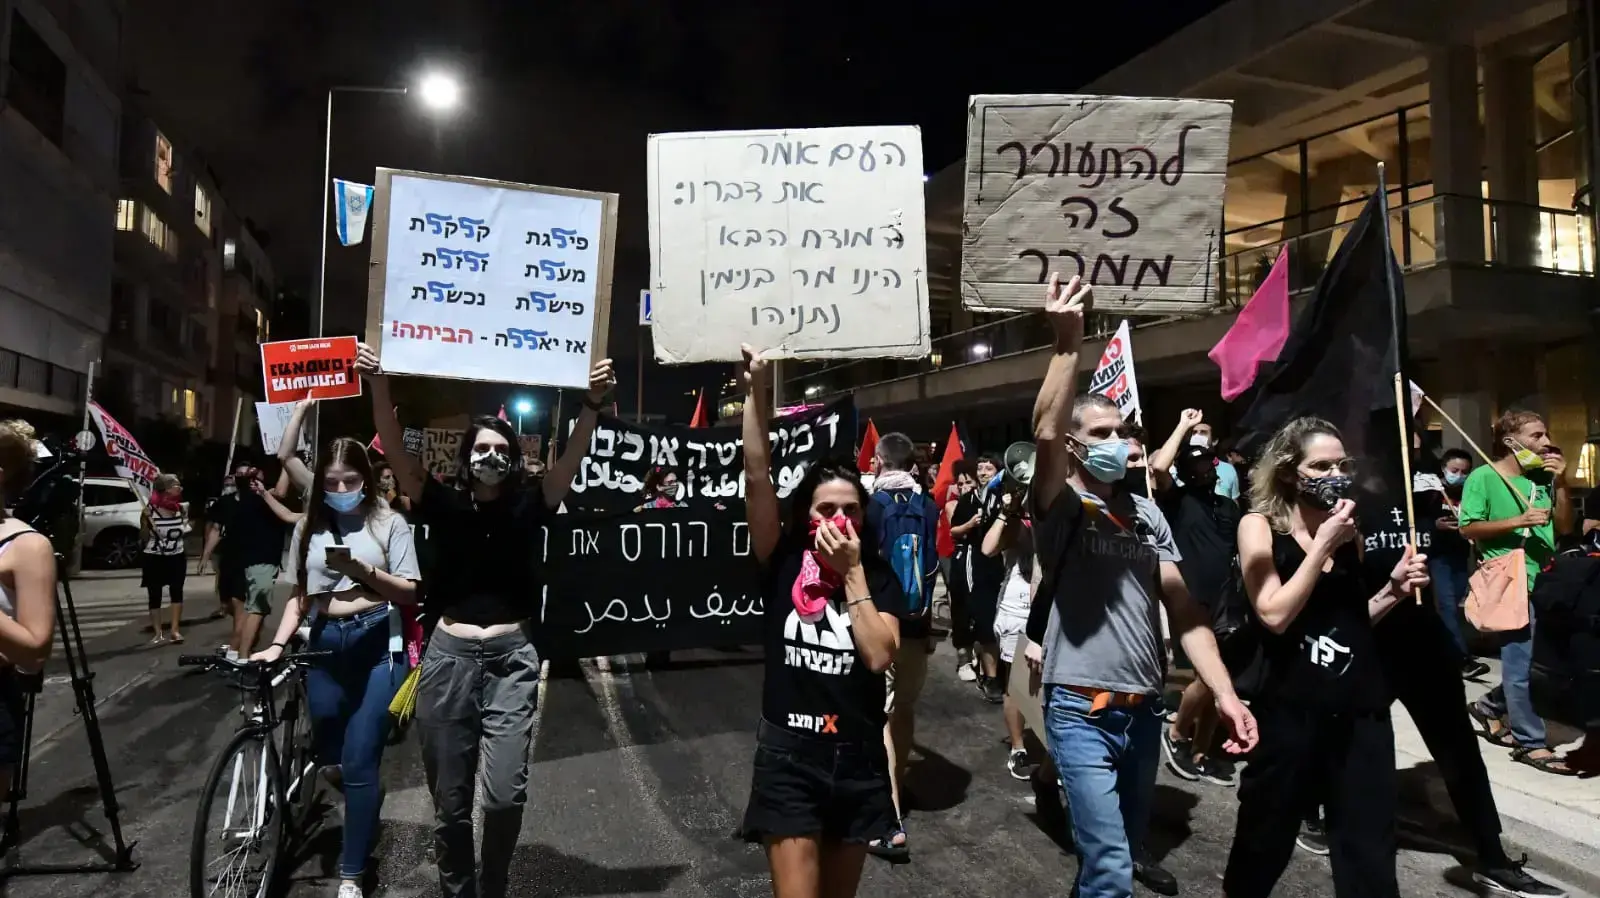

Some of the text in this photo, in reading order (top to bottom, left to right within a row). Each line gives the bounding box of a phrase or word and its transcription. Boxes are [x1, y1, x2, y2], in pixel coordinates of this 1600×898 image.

[747, 140, 906, 172] העם אמר
[997, 125, 1201, 189] להתעורר
[674, 181, 825, 206] את דברו:
[409, 213, 491, 242] קלקלת
[1061, 195, 1139, 238] זה
[525, 228, 589, 250] פילגת
[719, 226, 788, 247] הבא
[421, 247, 490, 272] זלזלת
[524, 259, 586, 283] מעלת
[411, 281, 486, 306] נכשלת
[700, 266, 901, 306] הינו מר בנימין
[515, 291, 585, 315] פישלת
[391, 320, 473, 344] הביתה!
[751, 304, 841, 335] נתניהו
[494, 327, 559, 350] יאללה
[565, 338, 587, 354] אז
[271, 373, 346, 391] מושחתים
[650, 435, 680, 466] או
[568, 528, 600, 556] את
[619, 521, 708, 562] הורס
[573, 594, 672, 634] يدمر
[784, 644, 855, 675] לנבצרות
[787, 712, 813, 729] מצב
